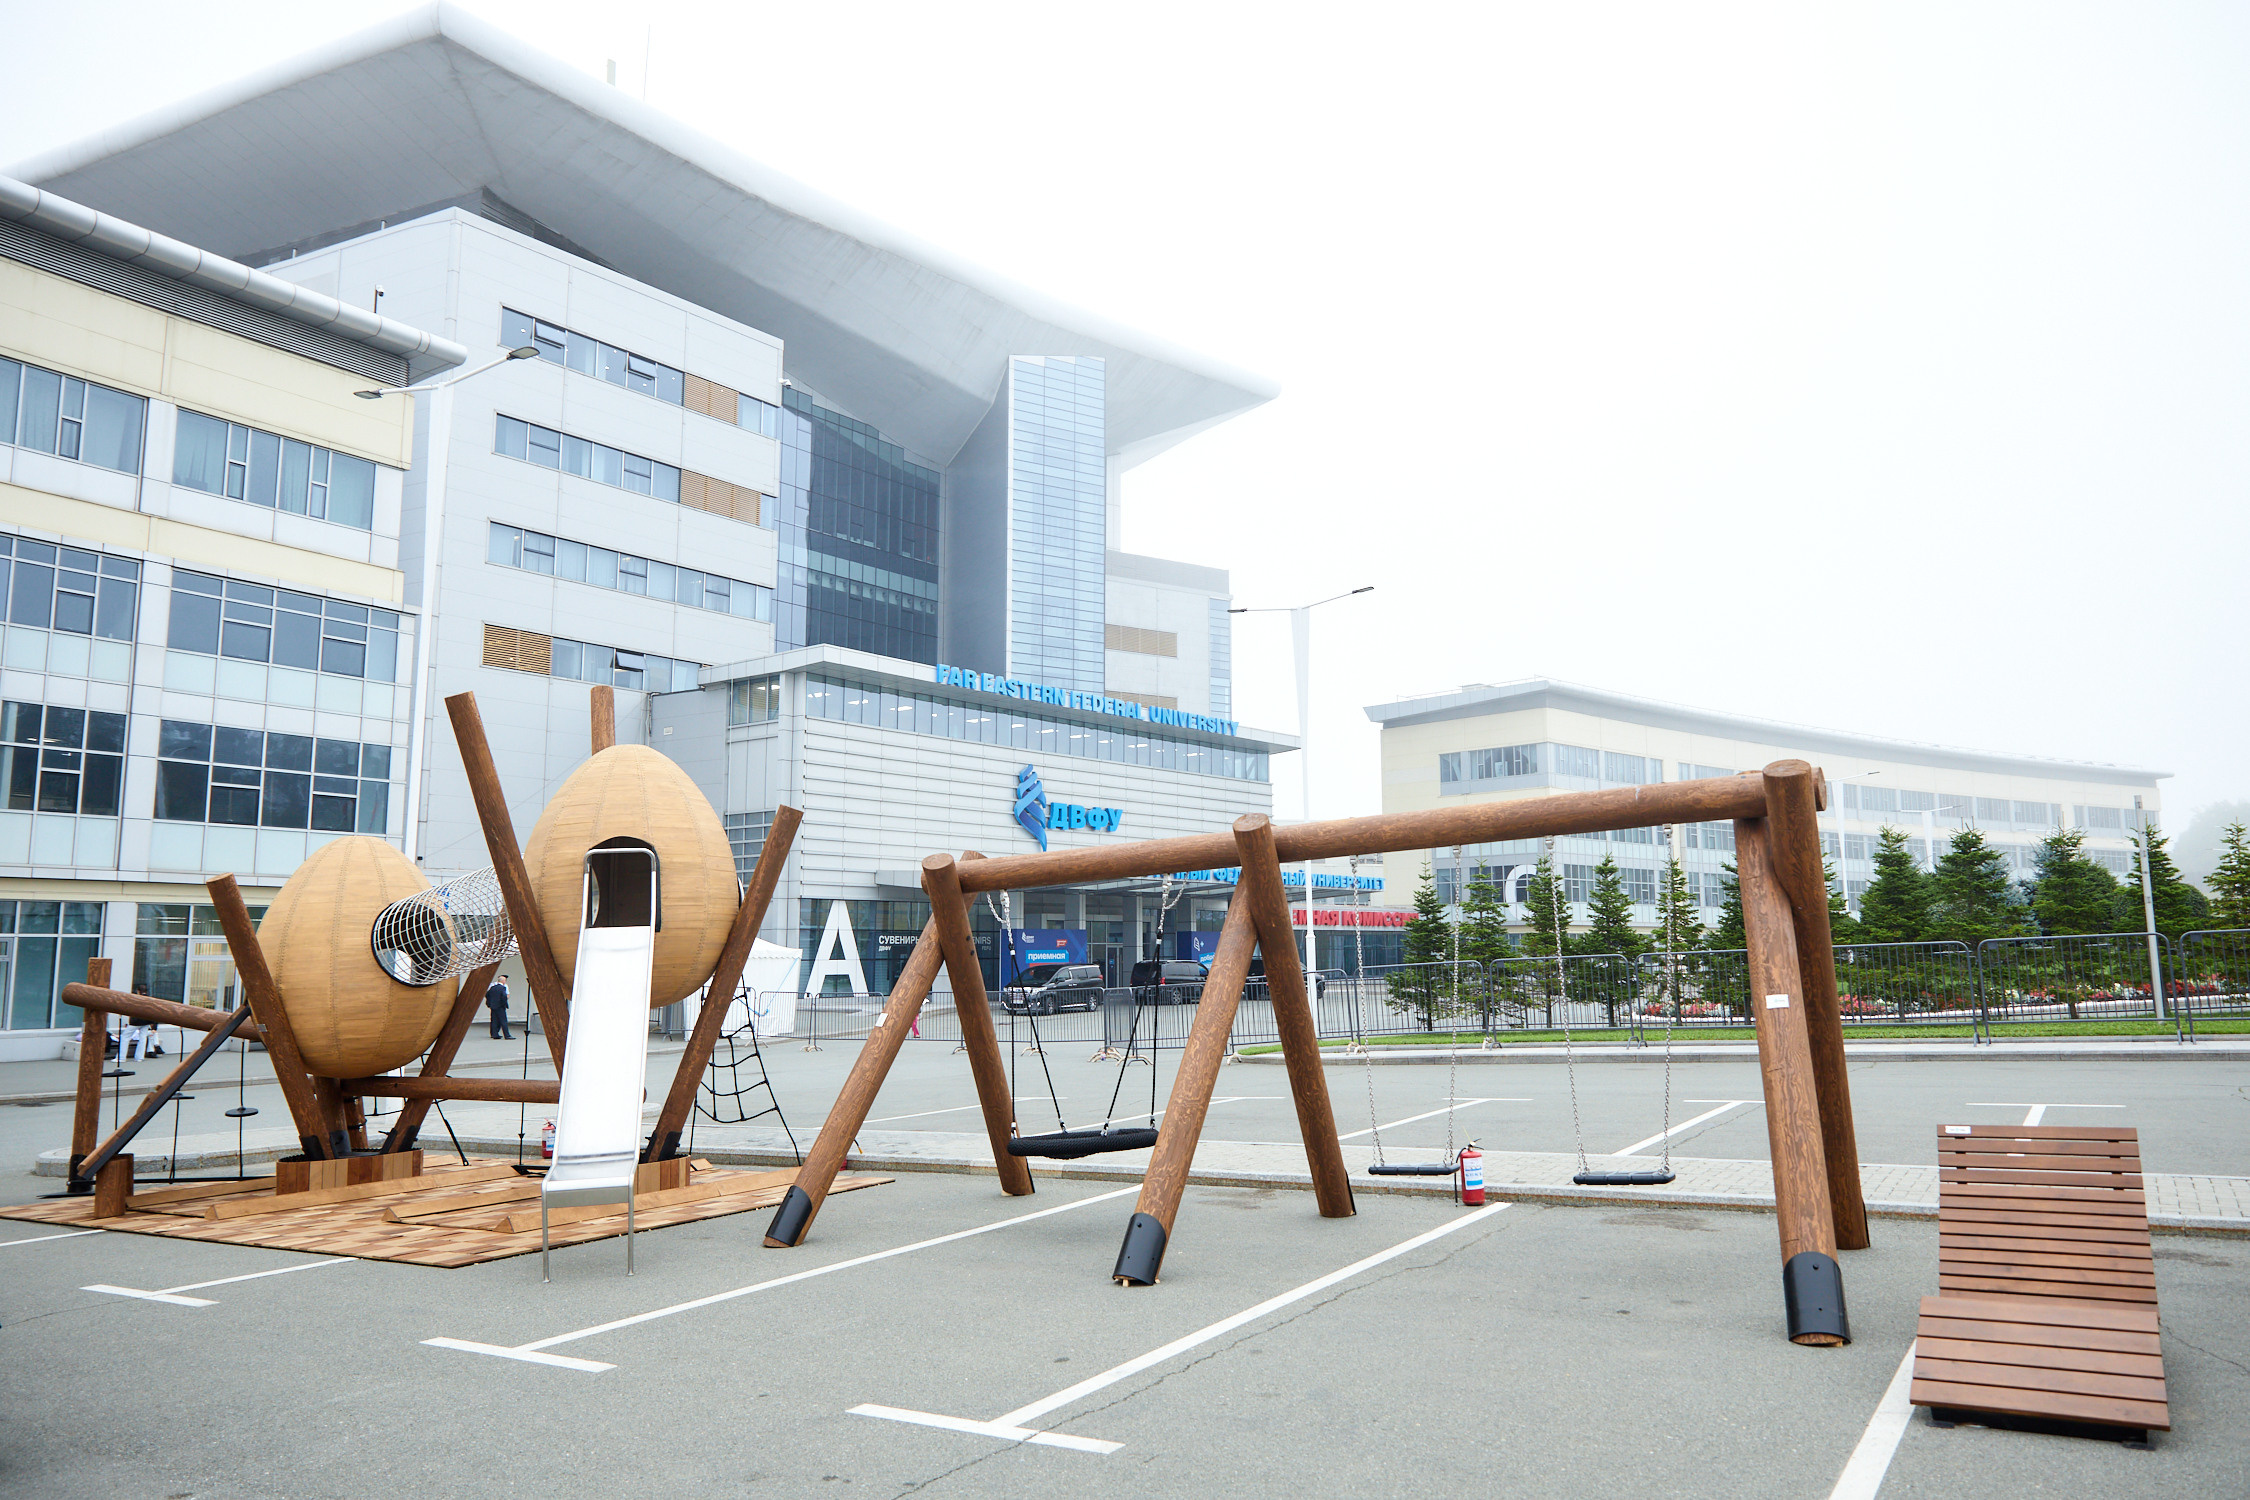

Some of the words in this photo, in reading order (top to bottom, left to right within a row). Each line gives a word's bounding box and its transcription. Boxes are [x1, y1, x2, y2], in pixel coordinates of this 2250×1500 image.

[936, 663, 977, 690] FAR
[981, 672, 1067, 706] EASTERN
[1070, 691, 1146, 721] FEDERAL
[1149, 706, 1240, 736] UNIVERSITY
[1047, 802, 1123, 832] ДВФУ
[1027, 953, 1066, 961] приемная
